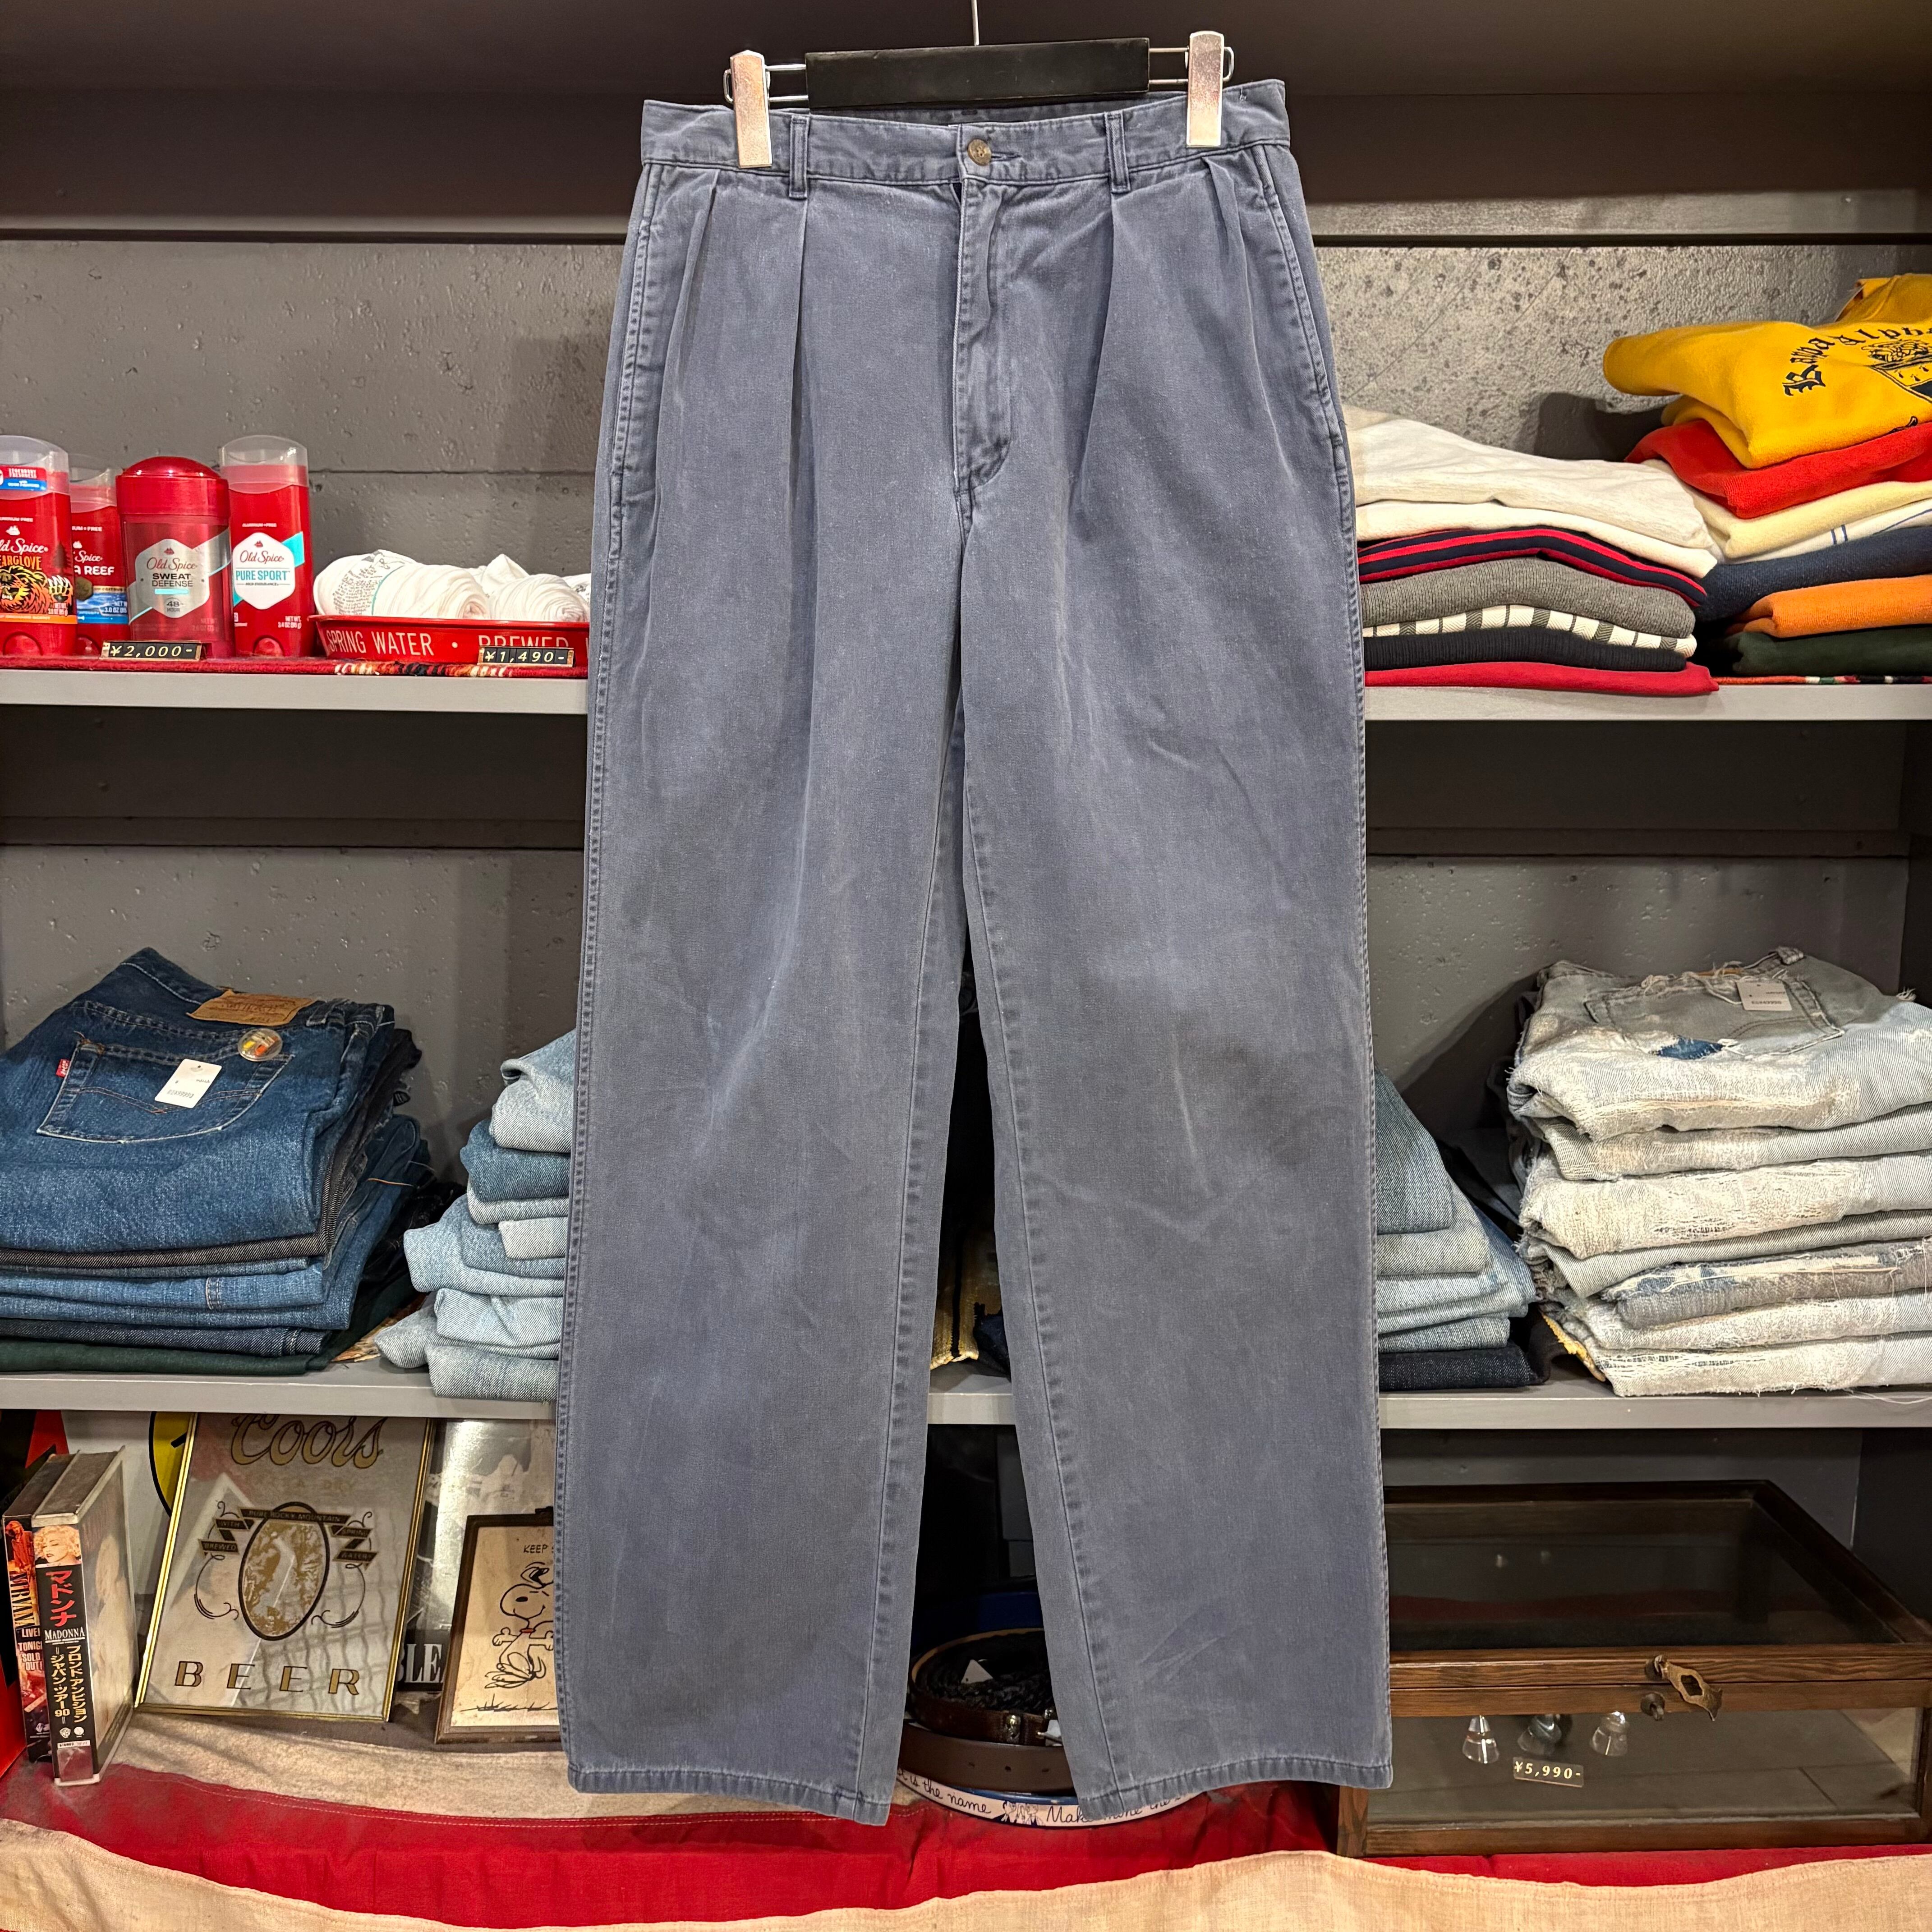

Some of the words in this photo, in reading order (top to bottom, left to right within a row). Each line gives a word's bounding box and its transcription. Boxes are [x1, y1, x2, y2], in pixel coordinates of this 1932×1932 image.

[0, 539, 11, 552] ld
[10, 538, 46, 555] Spice
[0, 555, 42, 570] ARGLOVE
[74, 550, 101, 564] Spice
[147, 557, 168, 570] Old
[168, 557, 196, 572] Spice
[240, 550, 257, 563] Old
[258, 551, 283, 564] Spice
[84, 566, 115, 575] REEF
[236, 570, 256, 580] PURE
[327, 630, 367, 653] SPRING
[371, 631, 434, 656] WATER
[523, 1544, 548, 1553] KEEP
[9, 1573, 35, 1629] NIRVANA
[46, 1570, 77, 1627] マドンナ
[44, 1626, 85, 1640] MADONNA
[18, 1641, 42, 1651] TONIG
[22, 1652, 41, 1662] SOLD
[175, 1661, 360, 1695] BEER
[923, 1778, 943, 1799] the
[948, 1793, 992, 1814] name
[1046, 1805, 1094, 1823] Mak
